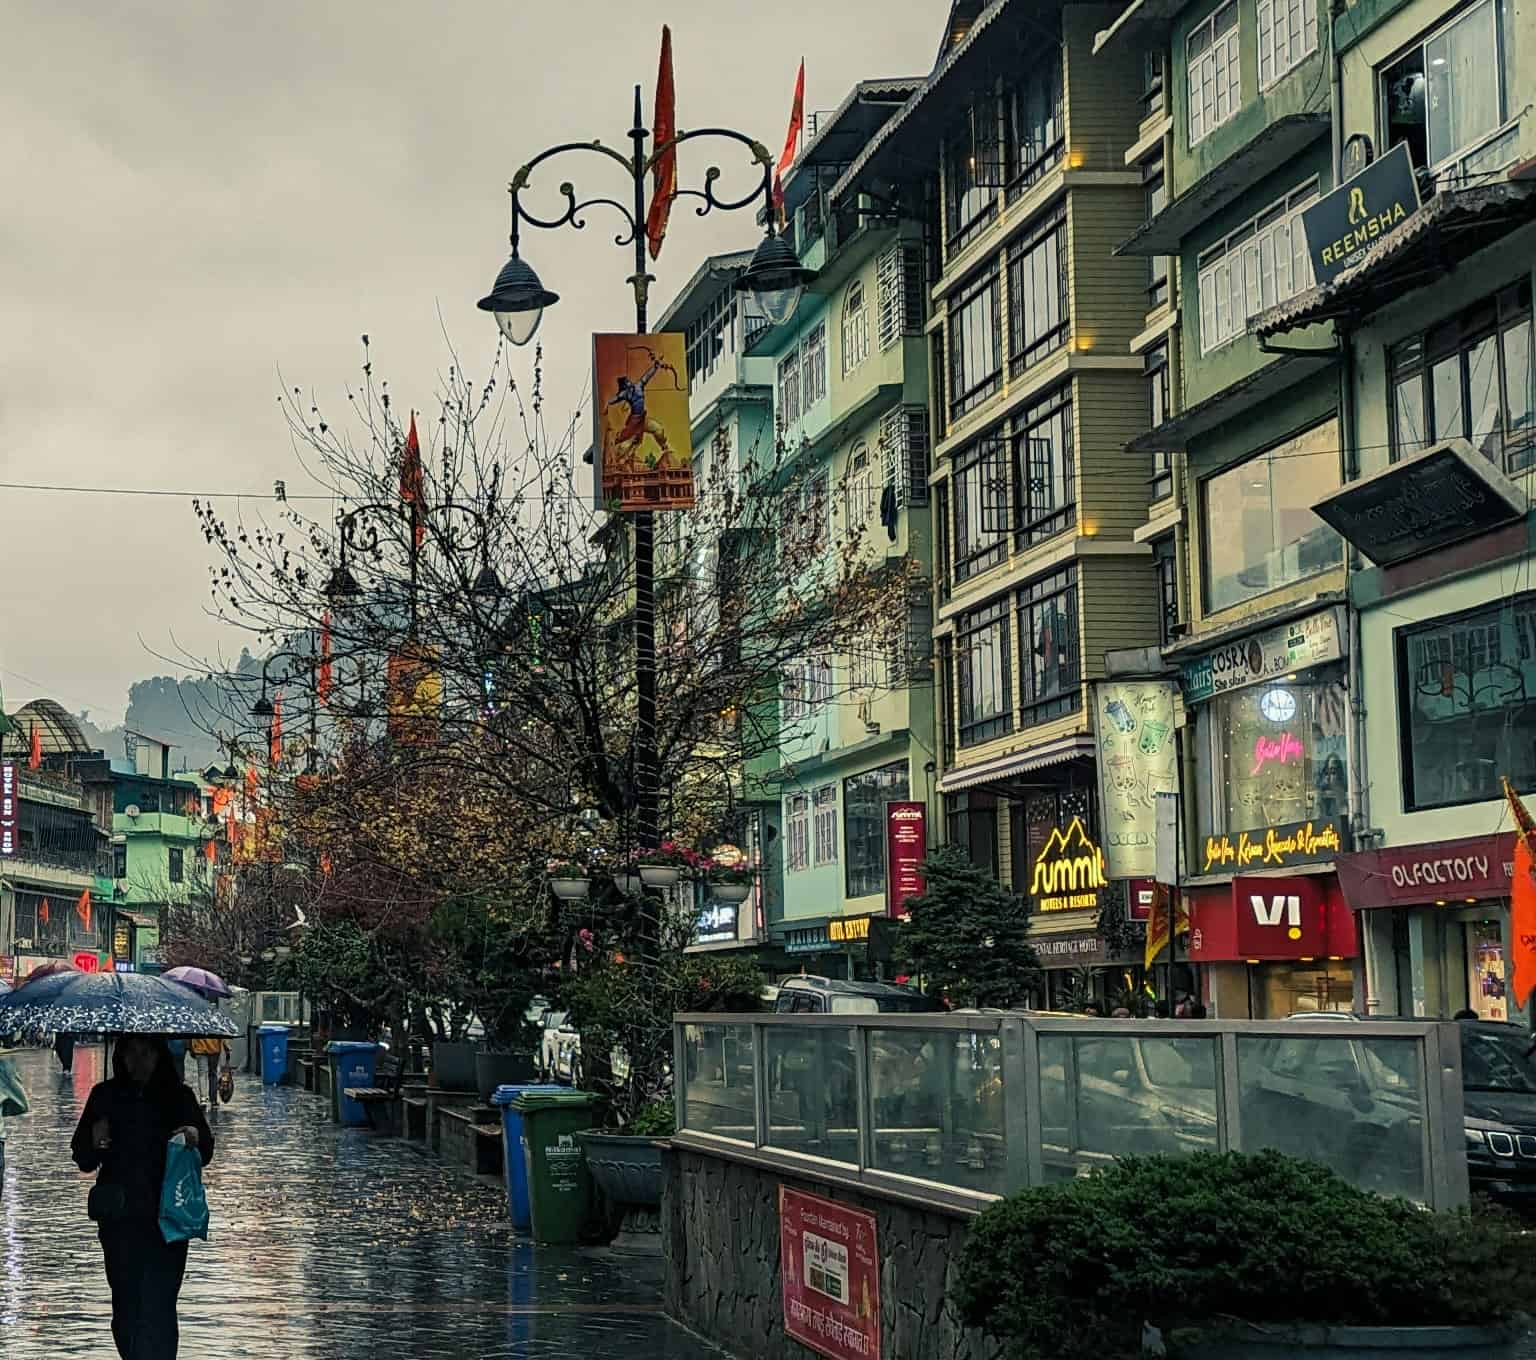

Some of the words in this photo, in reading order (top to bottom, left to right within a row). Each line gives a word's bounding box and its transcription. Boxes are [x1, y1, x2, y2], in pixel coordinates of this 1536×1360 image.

[1321, 201, 1406, 266] REEMSHA
[1211, 641, 1249, 675] COSRX
[1029, 846, 1108, 895] summit
[1391, 855, 1490, 889] OLFACTORY
